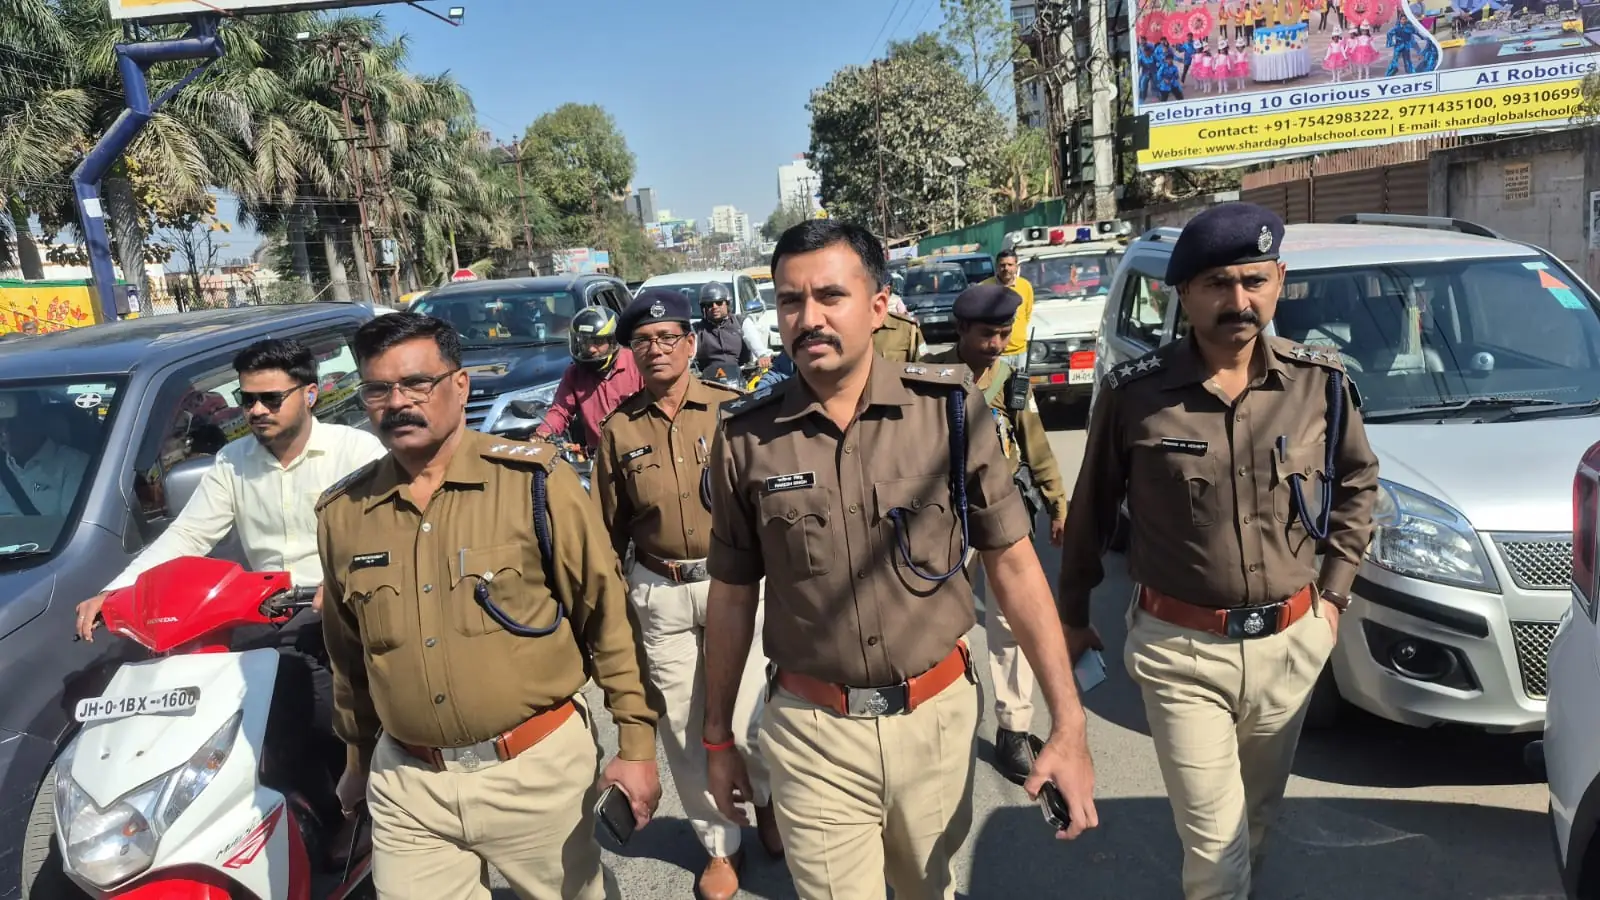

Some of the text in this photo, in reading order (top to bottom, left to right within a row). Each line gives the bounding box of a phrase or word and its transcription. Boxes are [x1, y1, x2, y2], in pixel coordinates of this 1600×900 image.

[1476, 61, 1597, 85] AI Robotics
[1145, 80, 1433, 121] Celebrating 10 Glorious Years
[1198, 87, 1585, 140] Contact: +91-7542983222, 9771435100, 99310699
[1152, 145, 1202, 160] Website:
[1206, 127, 1387, 154] www.shardaglobalschool.com
[1398, 119, 1441, 133] E-mail:
